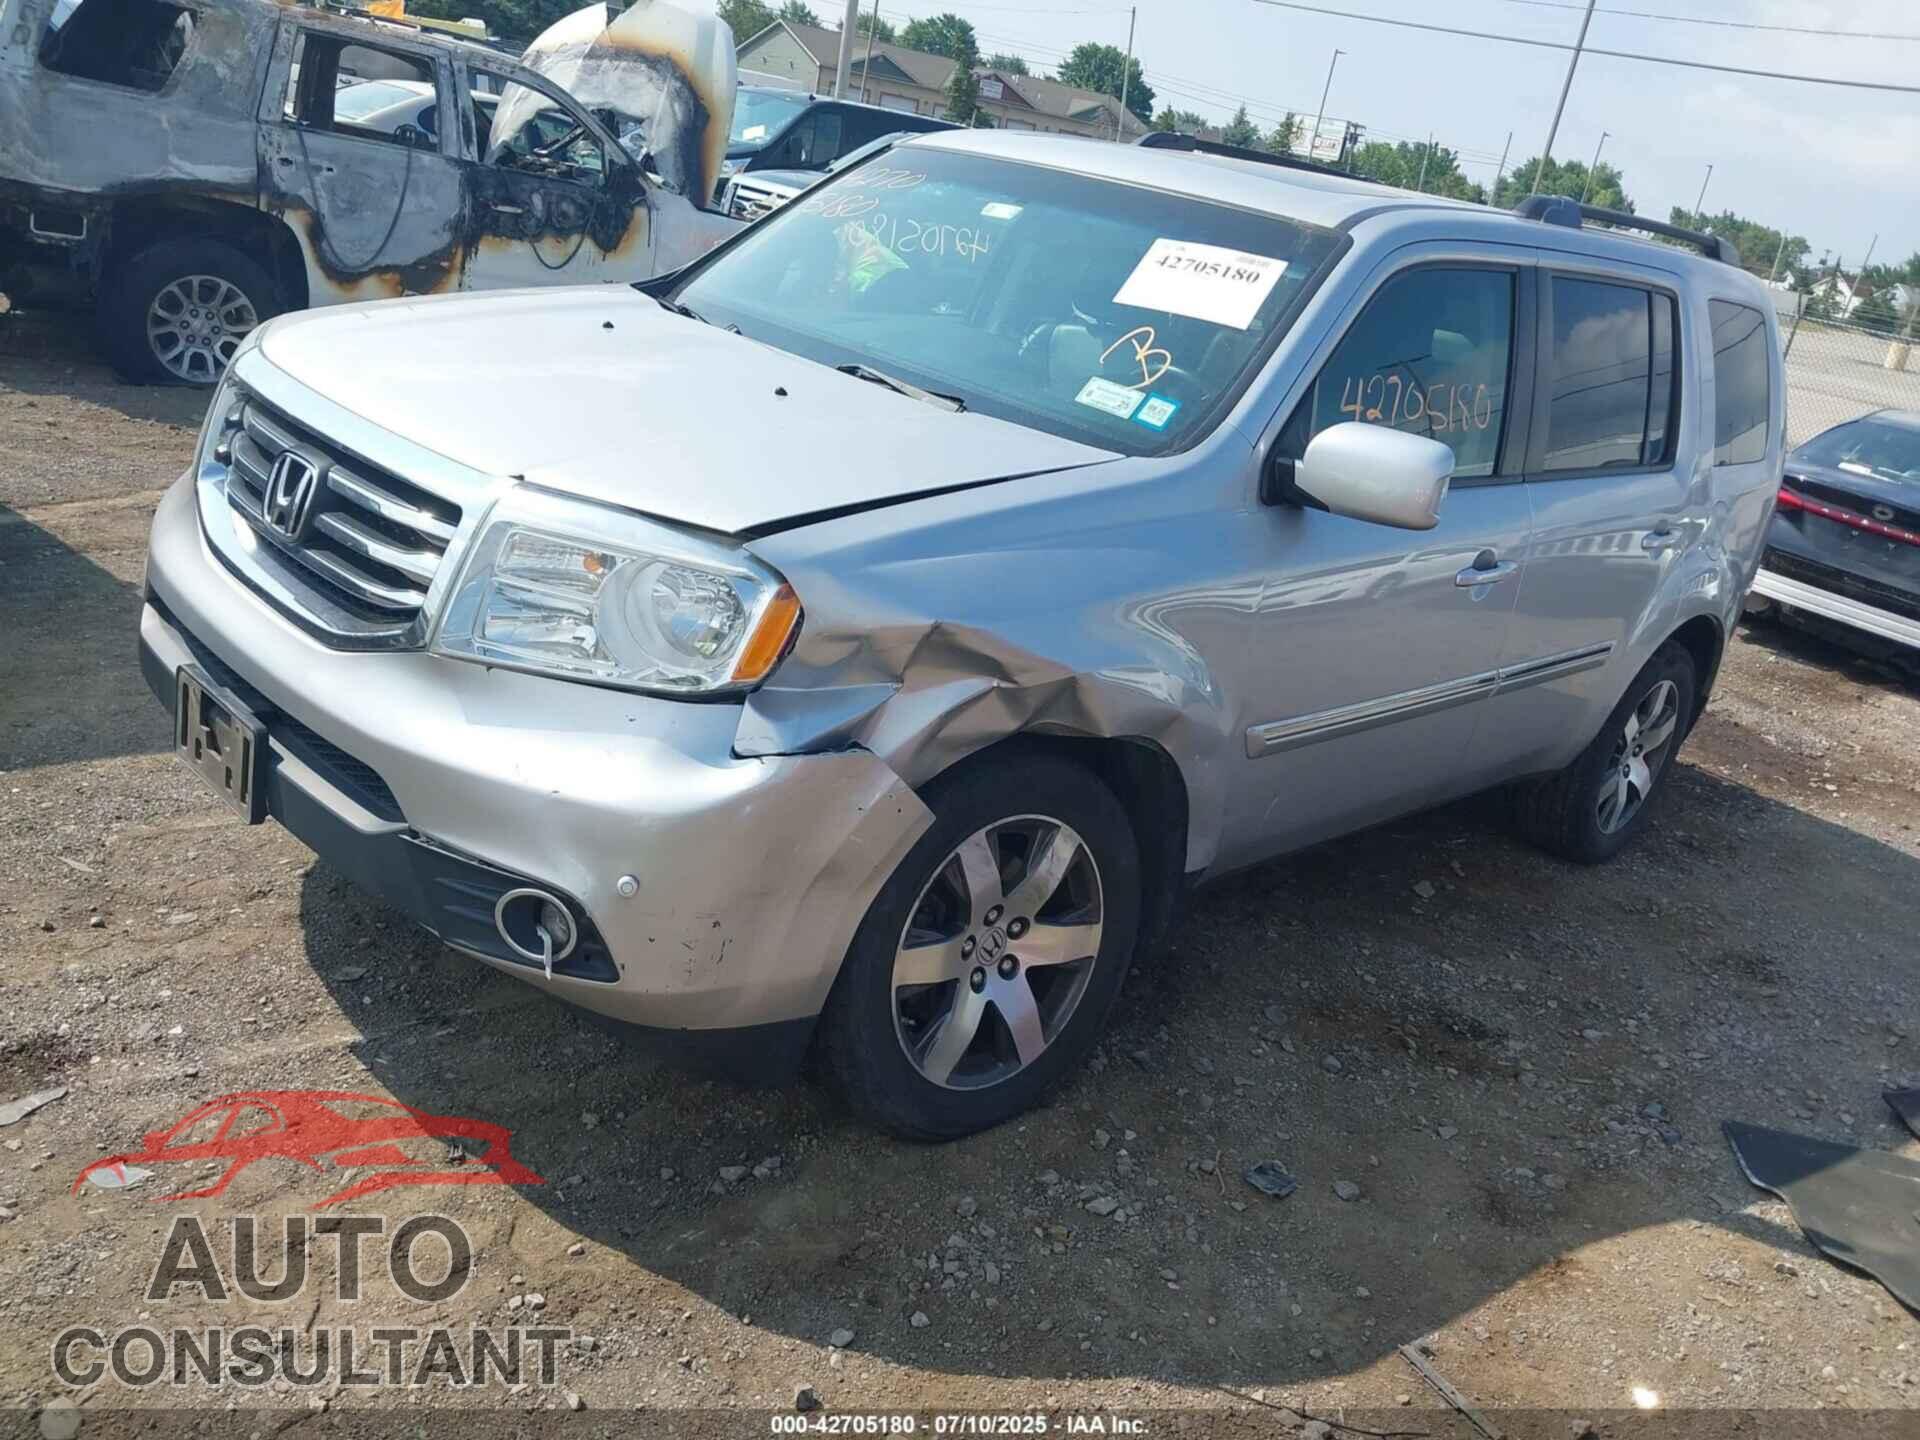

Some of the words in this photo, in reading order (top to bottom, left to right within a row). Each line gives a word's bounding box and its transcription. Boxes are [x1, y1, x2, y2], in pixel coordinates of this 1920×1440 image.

[1154, 255, 1261, 284] 42705180
[1100, 326, 1171, 390] B
[1340, 375, 1491, 432] 42705180
